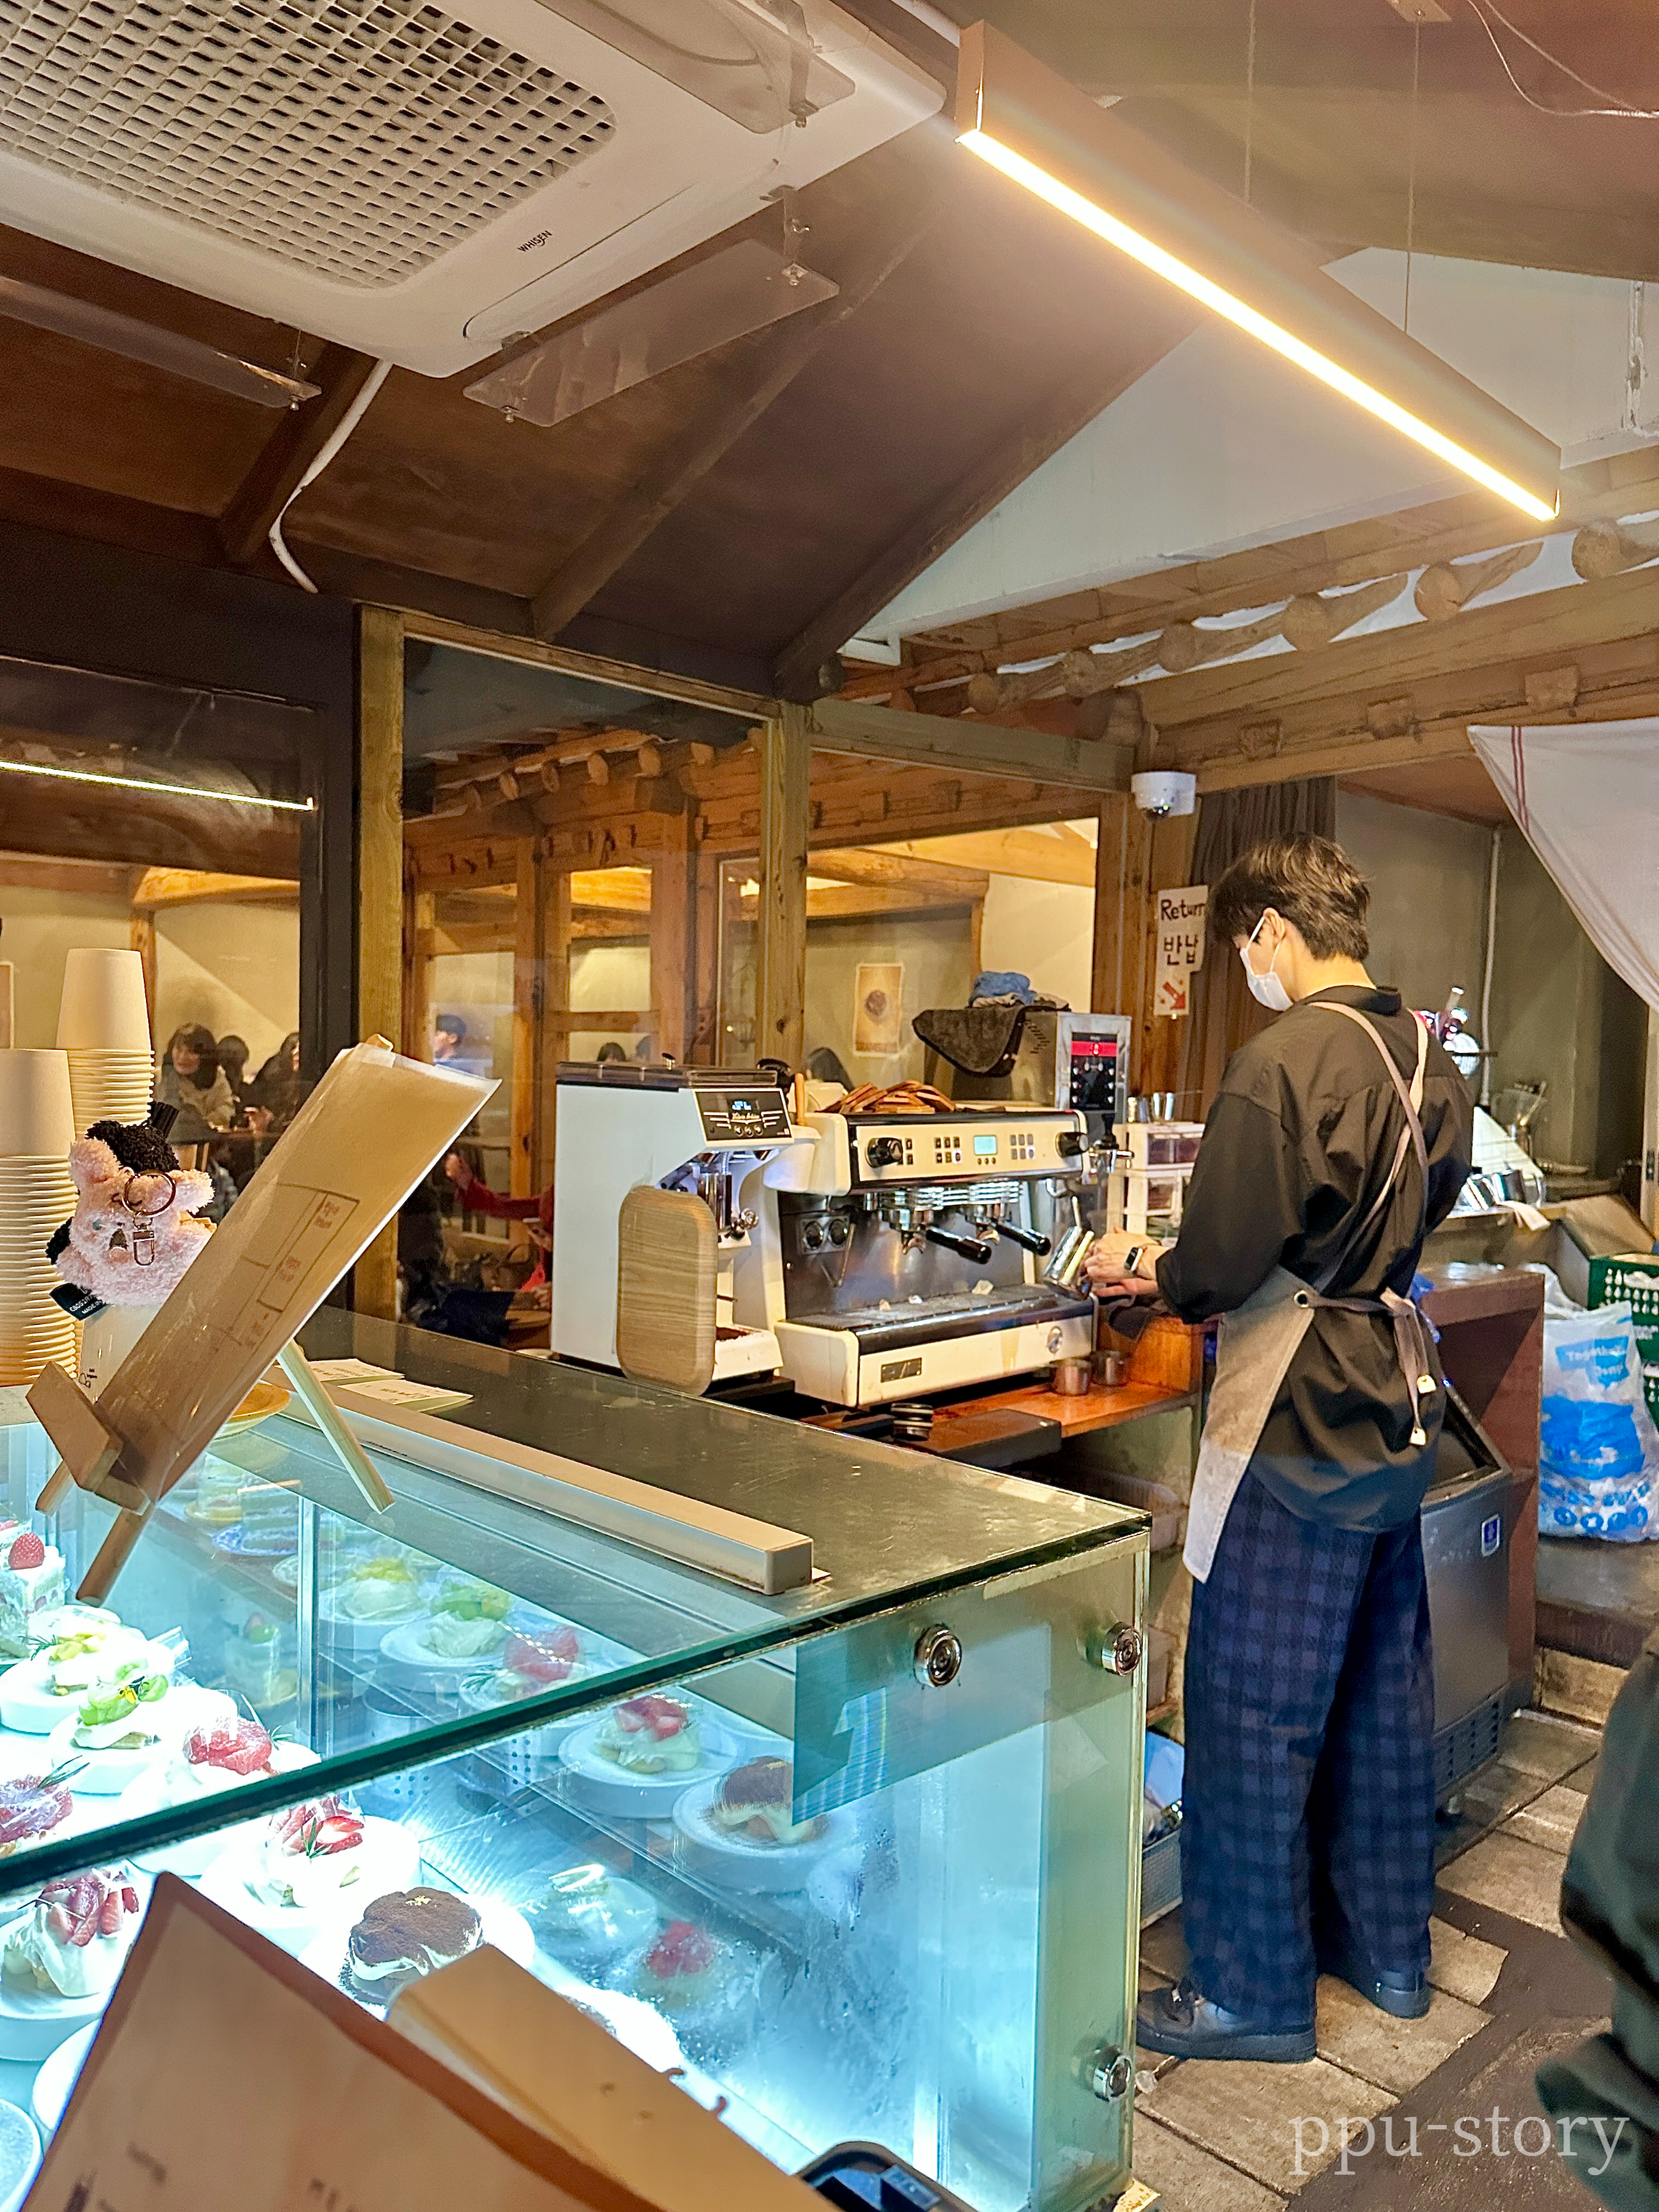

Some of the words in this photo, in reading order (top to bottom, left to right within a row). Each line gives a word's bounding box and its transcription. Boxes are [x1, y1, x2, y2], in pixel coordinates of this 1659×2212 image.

[517, 229, 552, 251] WHISEN
[1163, 934, 1198, 966] 반납
[81, 1303, 96, 1314] MADE
